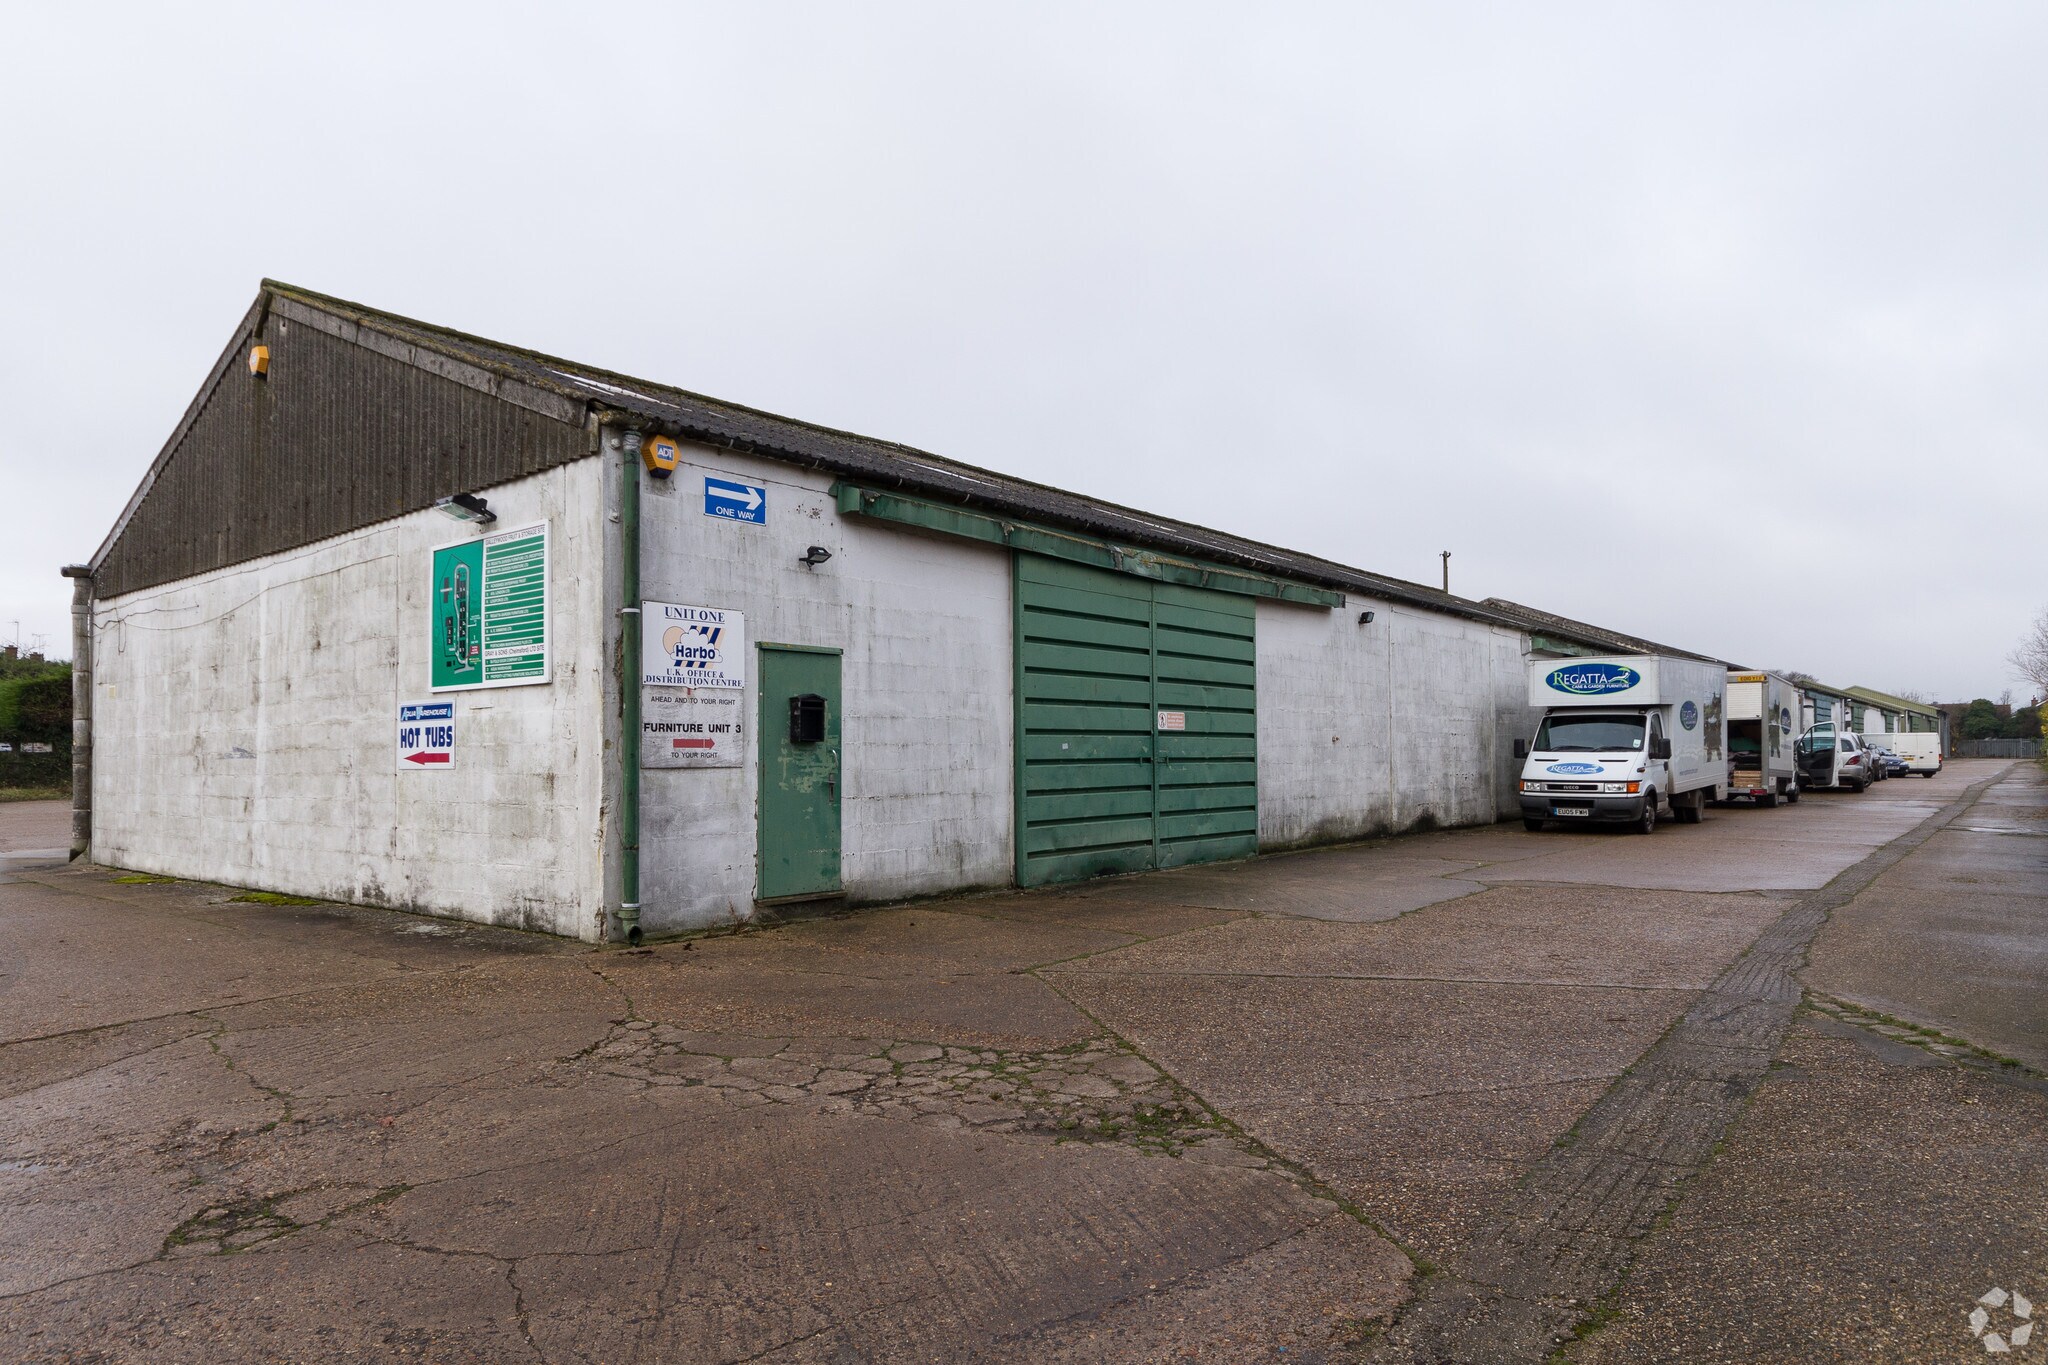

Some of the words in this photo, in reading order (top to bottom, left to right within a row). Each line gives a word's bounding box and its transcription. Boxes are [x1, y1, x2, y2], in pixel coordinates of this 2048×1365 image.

[658, 447, 674, 458] ADT
[716, 506, 735, 517] ONE
[738, 510, 755, 520] WAY
[665, 606, 696, 619] UNIT
[699, 610, 725, 622] ONE
[675, 644, 715, 660] Harbo
[666, 668, 683, 676] U.K.
[687, 669, 717, 678] OFFICE
[646, 675, 708, 685] DISTRIBUTION
[711, 679, 742, 687] CENTRE
[643, 723, 703, 732] FURNITURE
[708, 724, 730, 733] UNIT
[735, 724, 741, 733] 3
[400, 728, 421, 748] HOT
[425, 726, 453, 748] TUBS
